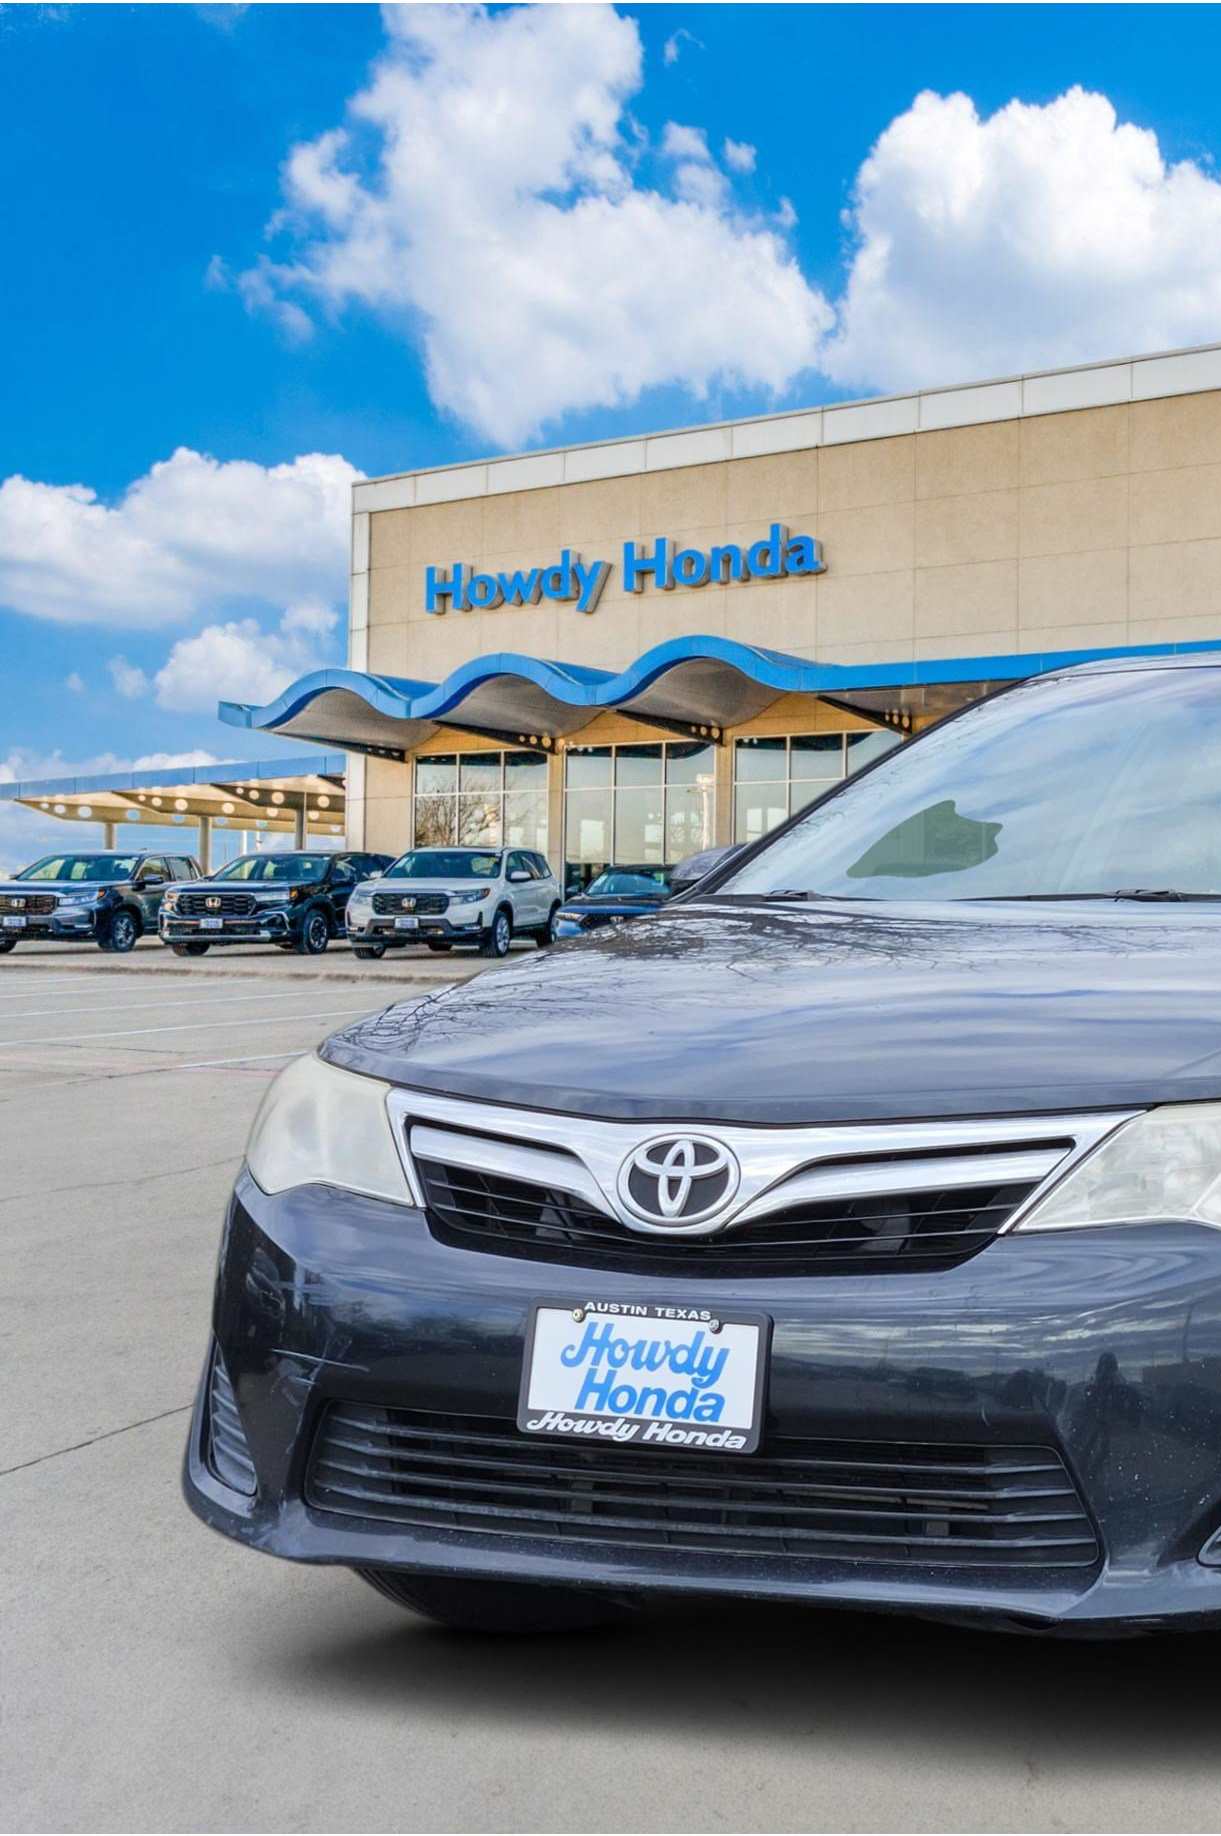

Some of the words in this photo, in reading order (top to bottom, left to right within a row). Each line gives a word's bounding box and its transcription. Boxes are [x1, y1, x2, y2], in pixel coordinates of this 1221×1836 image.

[426, 548, 611, 614] Howdy
[623, 523, 825, 593] Honda
[584, 1301, 647, 1316] AUSTIN
[655, 1307, 712, 1321] TEXAS
[560, 1321, 731, 1388] Howdy
[574, 1368, 725, 1423] Honda
[527, 1412, 640, 1442] Howdy
[642, 1422, 747, 1450] Honda
